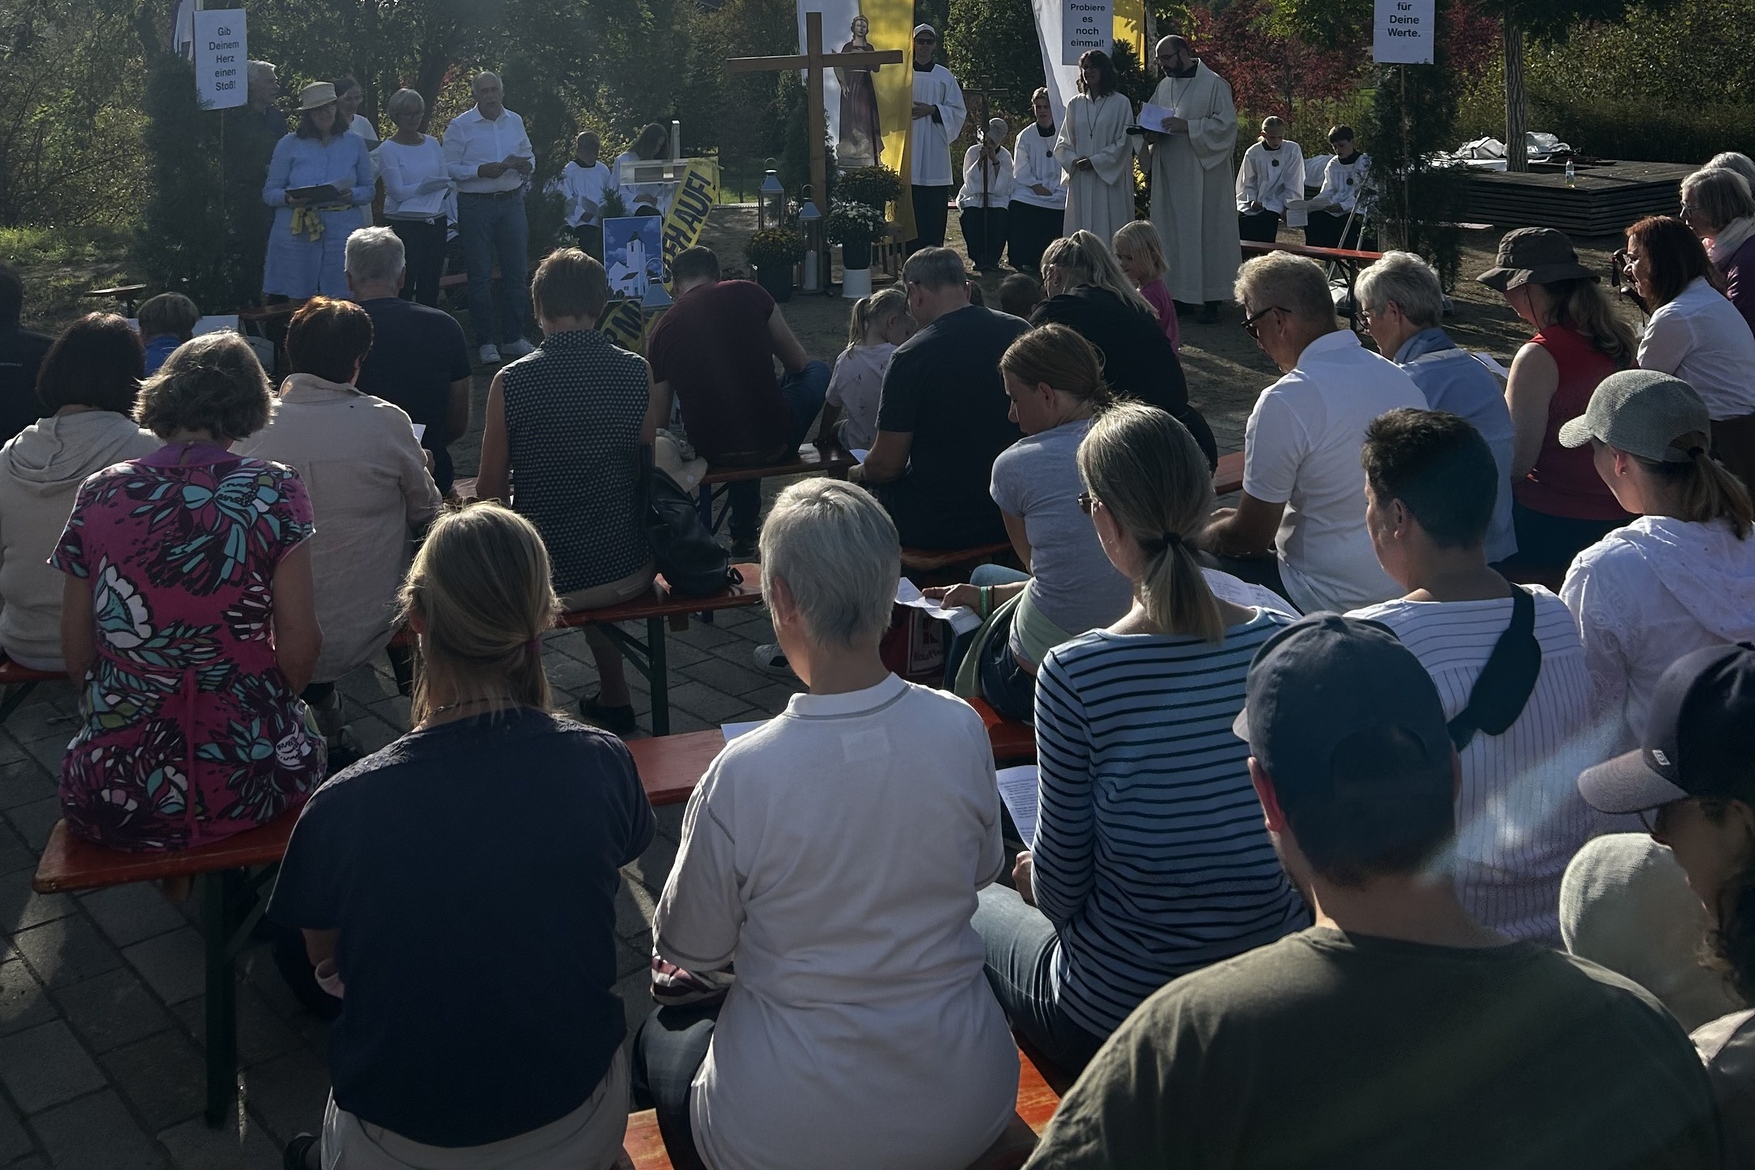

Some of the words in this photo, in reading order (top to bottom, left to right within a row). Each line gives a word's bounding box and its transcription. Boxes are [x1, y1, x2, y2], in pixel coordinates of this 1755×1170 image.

[1070, 3, 1105, 12] Probiere
[1397, 2, 1412, 11] für
[1389, 15, 1420, 25] Deine
[217, 27, 231, 36] Gib
[1076, 27, 1099, 35] noch
[1387, 27, 1421, 37] Werte.
[209, 41, 240, 51] Deinem
[1070, 39, 1104, 47] einmal!
[216, 55, 235, 63] Herz
[214, 68, 236, 77] einen
[215, 81, 236, 91] Stoß!
[673, 170, 716, 235] AUF!
